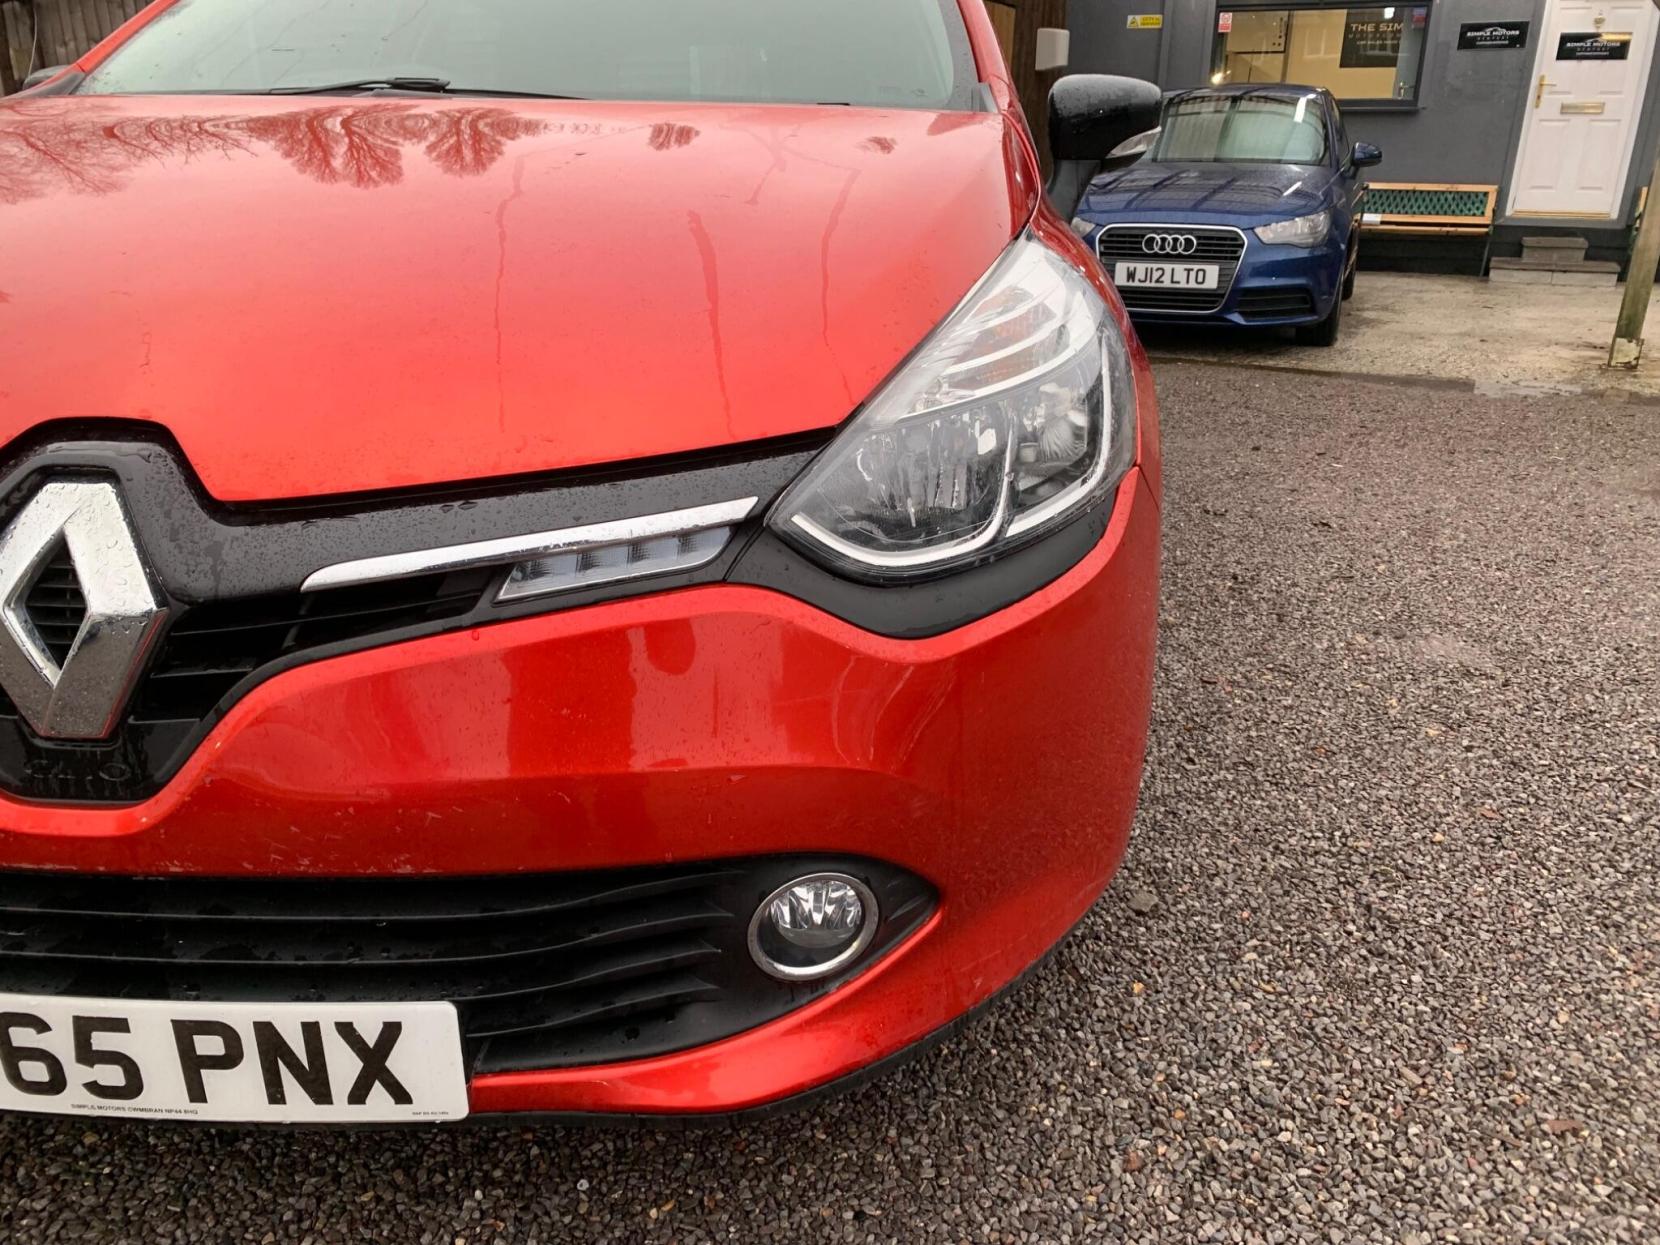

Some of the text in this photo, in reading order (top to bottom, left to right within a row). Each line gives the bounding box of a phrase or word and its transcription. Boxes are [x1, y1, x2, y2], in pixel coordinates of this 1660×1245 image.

[1350, 22, 1404, 31] THE SIM
[1126, 266, 1206, 285] WJ12 LTO
[0, 1011, 413, 1105] 65 PNX
